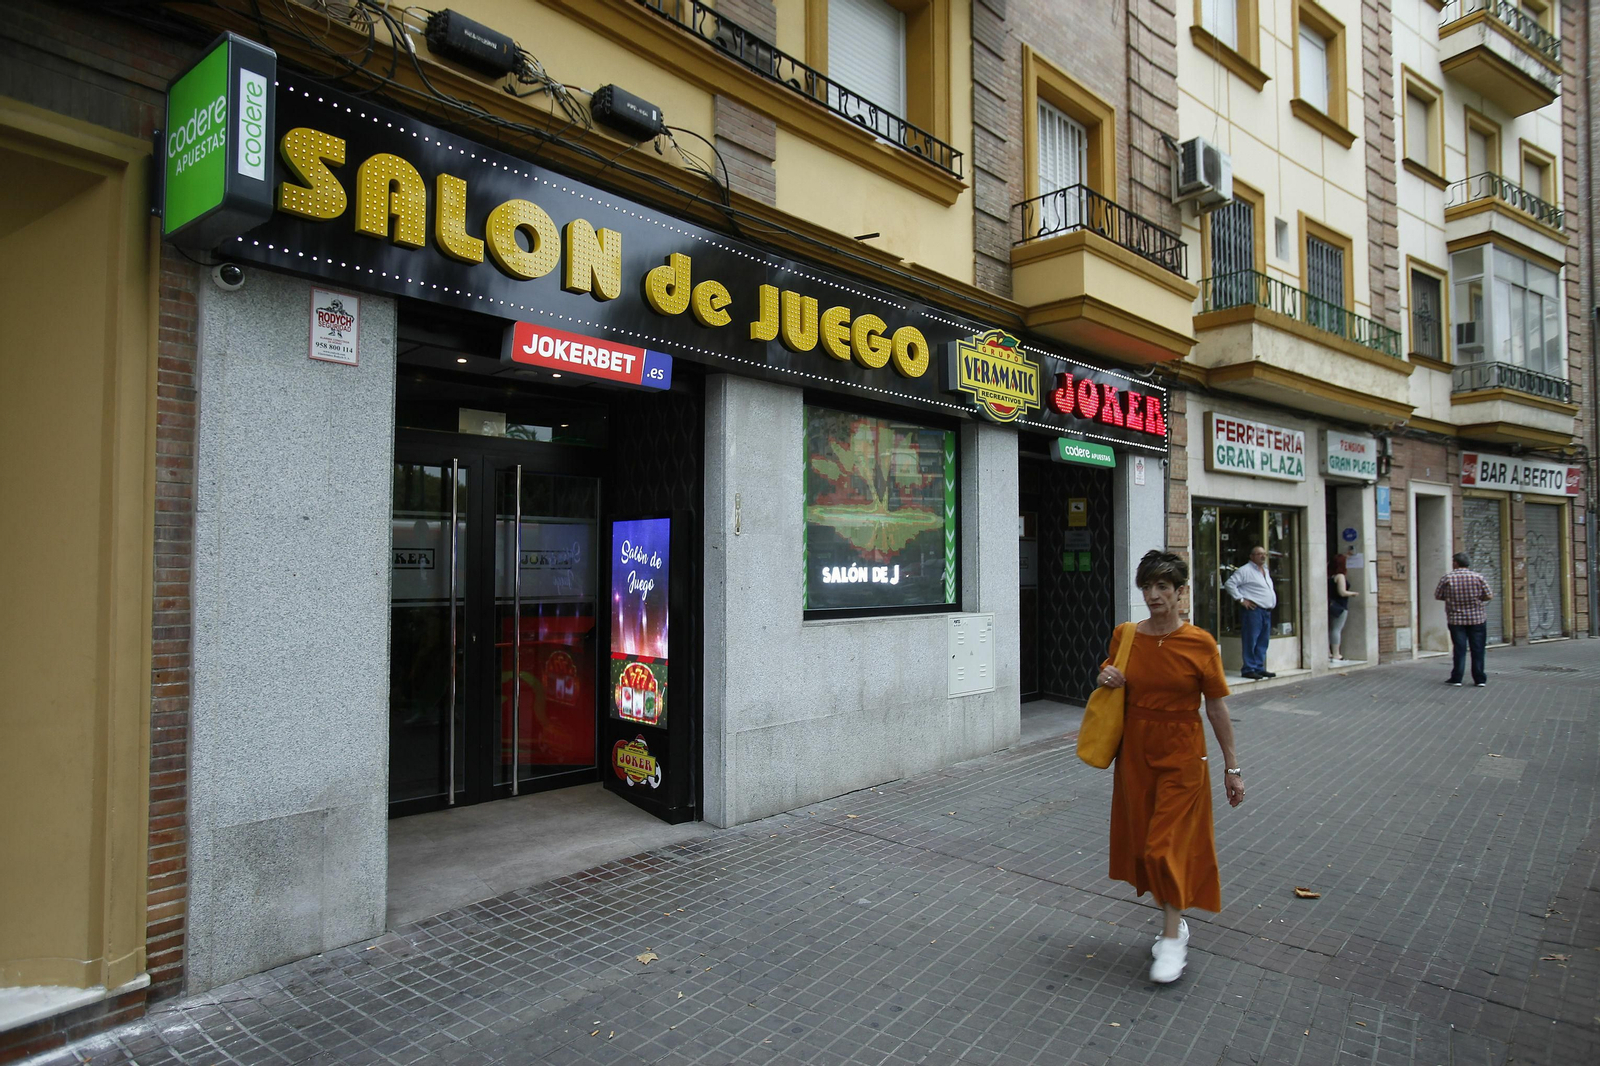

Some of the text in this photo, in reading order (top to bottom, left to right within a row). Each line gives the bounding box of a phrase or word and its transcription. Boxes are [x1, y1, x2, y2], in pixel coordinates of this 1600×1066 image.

[168, 95, 227, 159] codere
[241, 81, 263, 168] codere
[175, 127, 226, 176] APUESTAS
[278, 127, 929, 378] SALON de JUEGO
[317, 311, 352, 327] RODYCH
[317, 320, 352, 333] SEGURIDAD
[315, 341, 328, 349] 958
[328, 343, 341, 351] 800
[522, 333, 665, 380] JOKERBET .es
[981, 346, 1019, 362] GRUPO
[964, 354, 1035, 396] VERAMATIC
[981, 390, 1022, 405] RECREATIVOS
[1053, 372, 1167, 436] JOKER
[1215, 418, 1304, 455] FERRETERIA
[1340, 439, 1366, 454] PENSION
[1064, 445, 1112, 462] codere APUESTAS
[1216, 444, 1304, 477] GRAN PLAZA
[1329, 455, 1376, 475] GRAN PLAZA
[1480, 460, 1508, 484] BAR
[621, 540, 663, 570] Salón de
[627, 570, 655, 601] Juego
[822, 562, 900, 585] SALÓN DE J
[619, 752, 653, 773] JOKER
